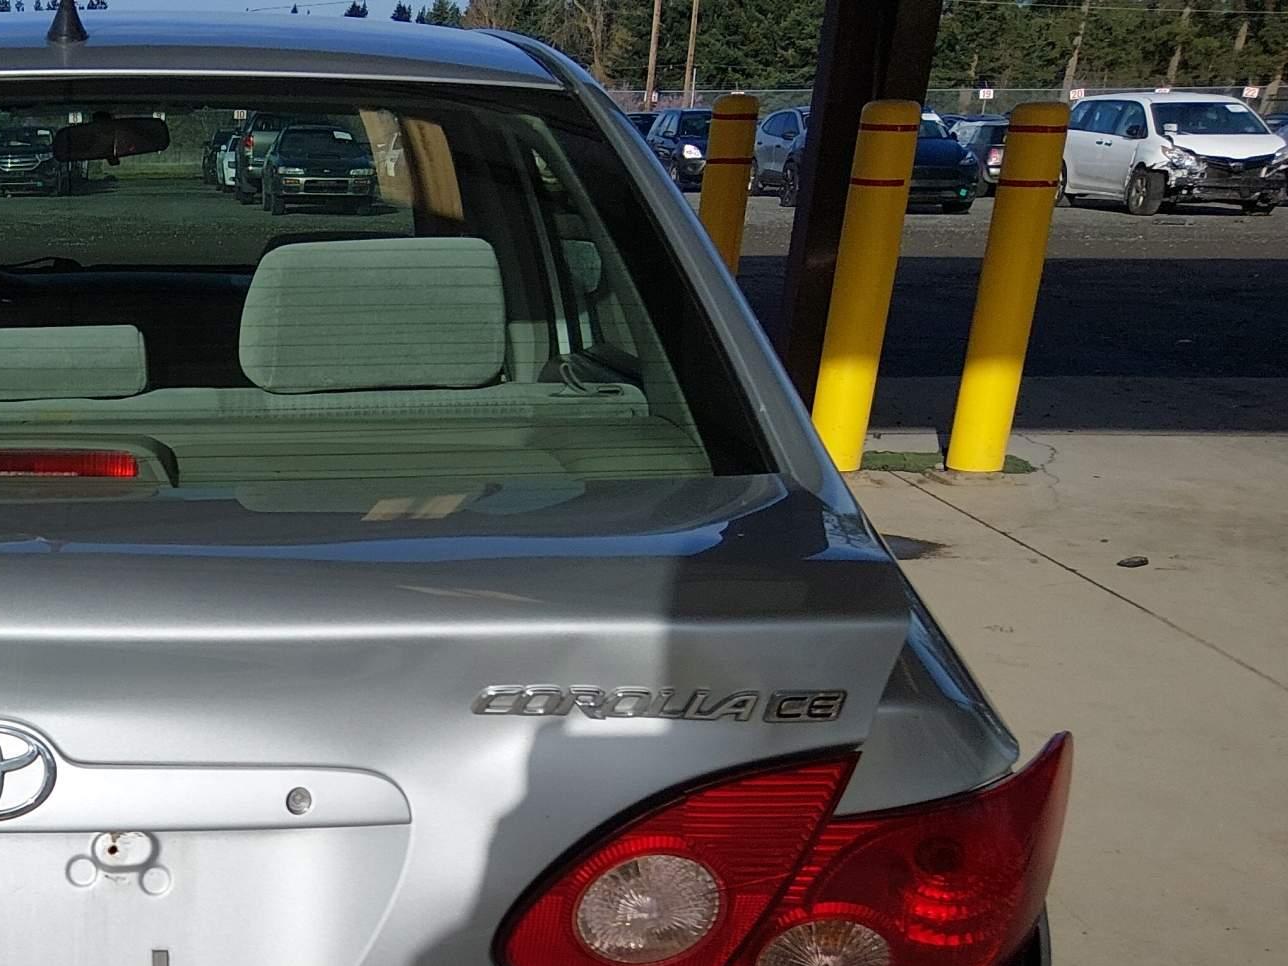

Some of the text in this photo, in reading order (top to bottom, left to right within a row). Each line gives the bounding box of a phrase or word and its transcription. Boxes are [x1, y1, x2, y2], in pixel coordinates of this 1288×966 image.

[236, 110, 245, 119] 10
[471, 684, 844, 721] COROLLA CE
